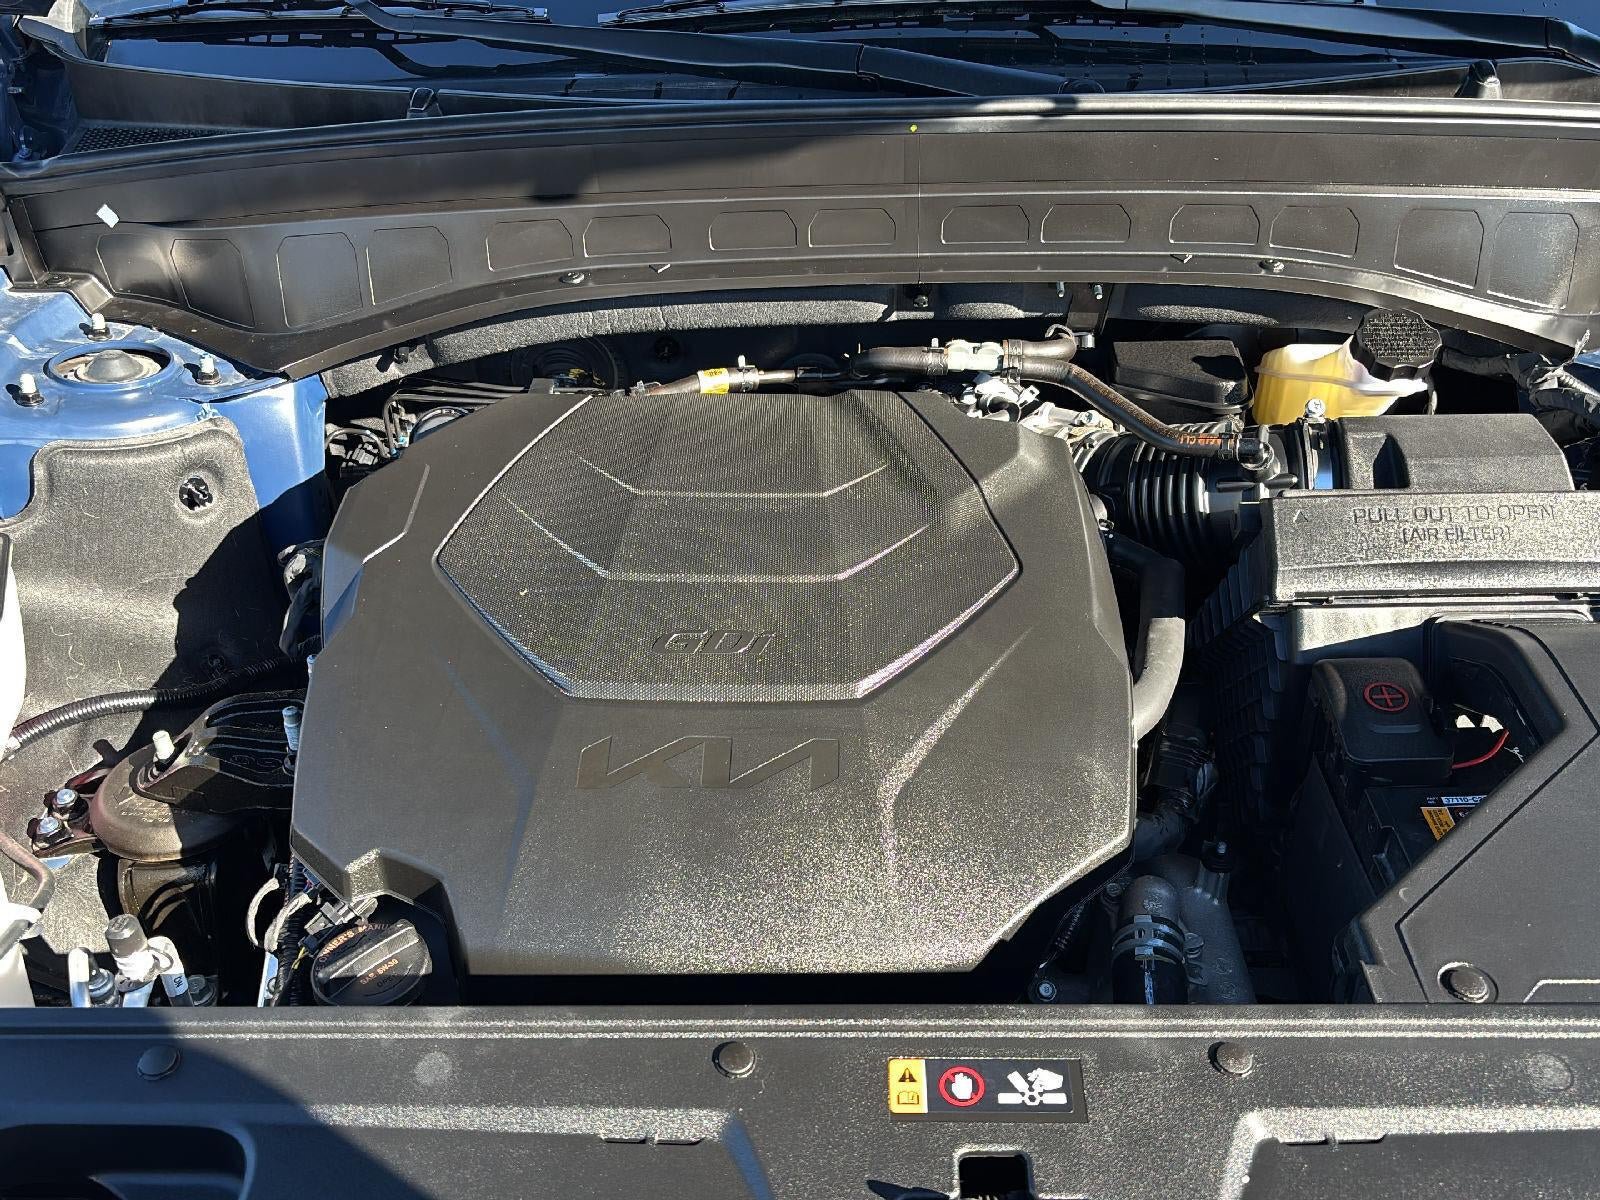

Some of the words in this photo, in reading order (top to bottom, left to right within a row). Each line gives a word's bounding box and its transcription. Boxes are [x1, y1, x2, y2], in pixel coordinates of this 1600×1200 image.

[1353, 506, 1408, 524] PULL
[1414, 505, 1457, 523] OUT
[1460, 505, 1489, 522] TO
[1497, 504, 1555, 521] OPEN
[576, 735, 839, 792] KIA
[318, 930, 355, 963] OWNER'S
